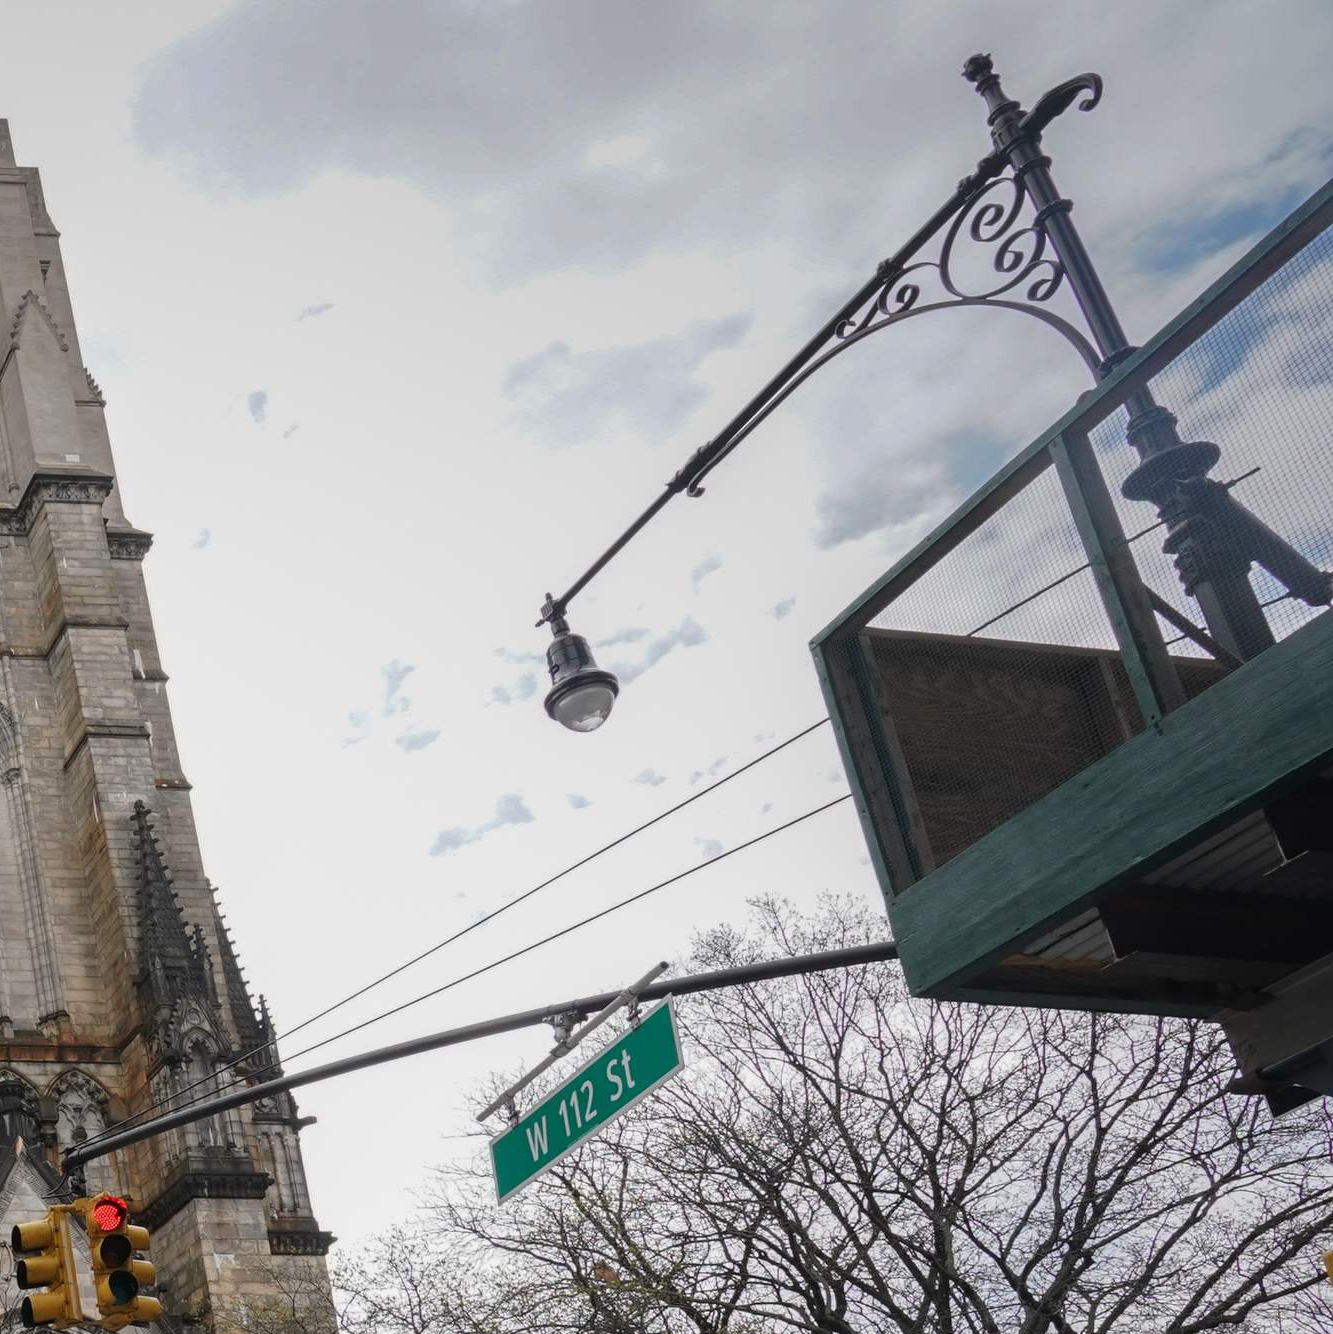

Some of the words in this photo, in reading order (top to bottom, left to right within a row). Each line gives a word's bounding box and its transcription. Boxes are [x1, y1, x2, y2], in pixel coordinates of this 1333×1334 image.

[526, 1115, 549, 1162] W
[558, 1080, 598, 1138] 112
[606, 1048, 636, 1102] St
